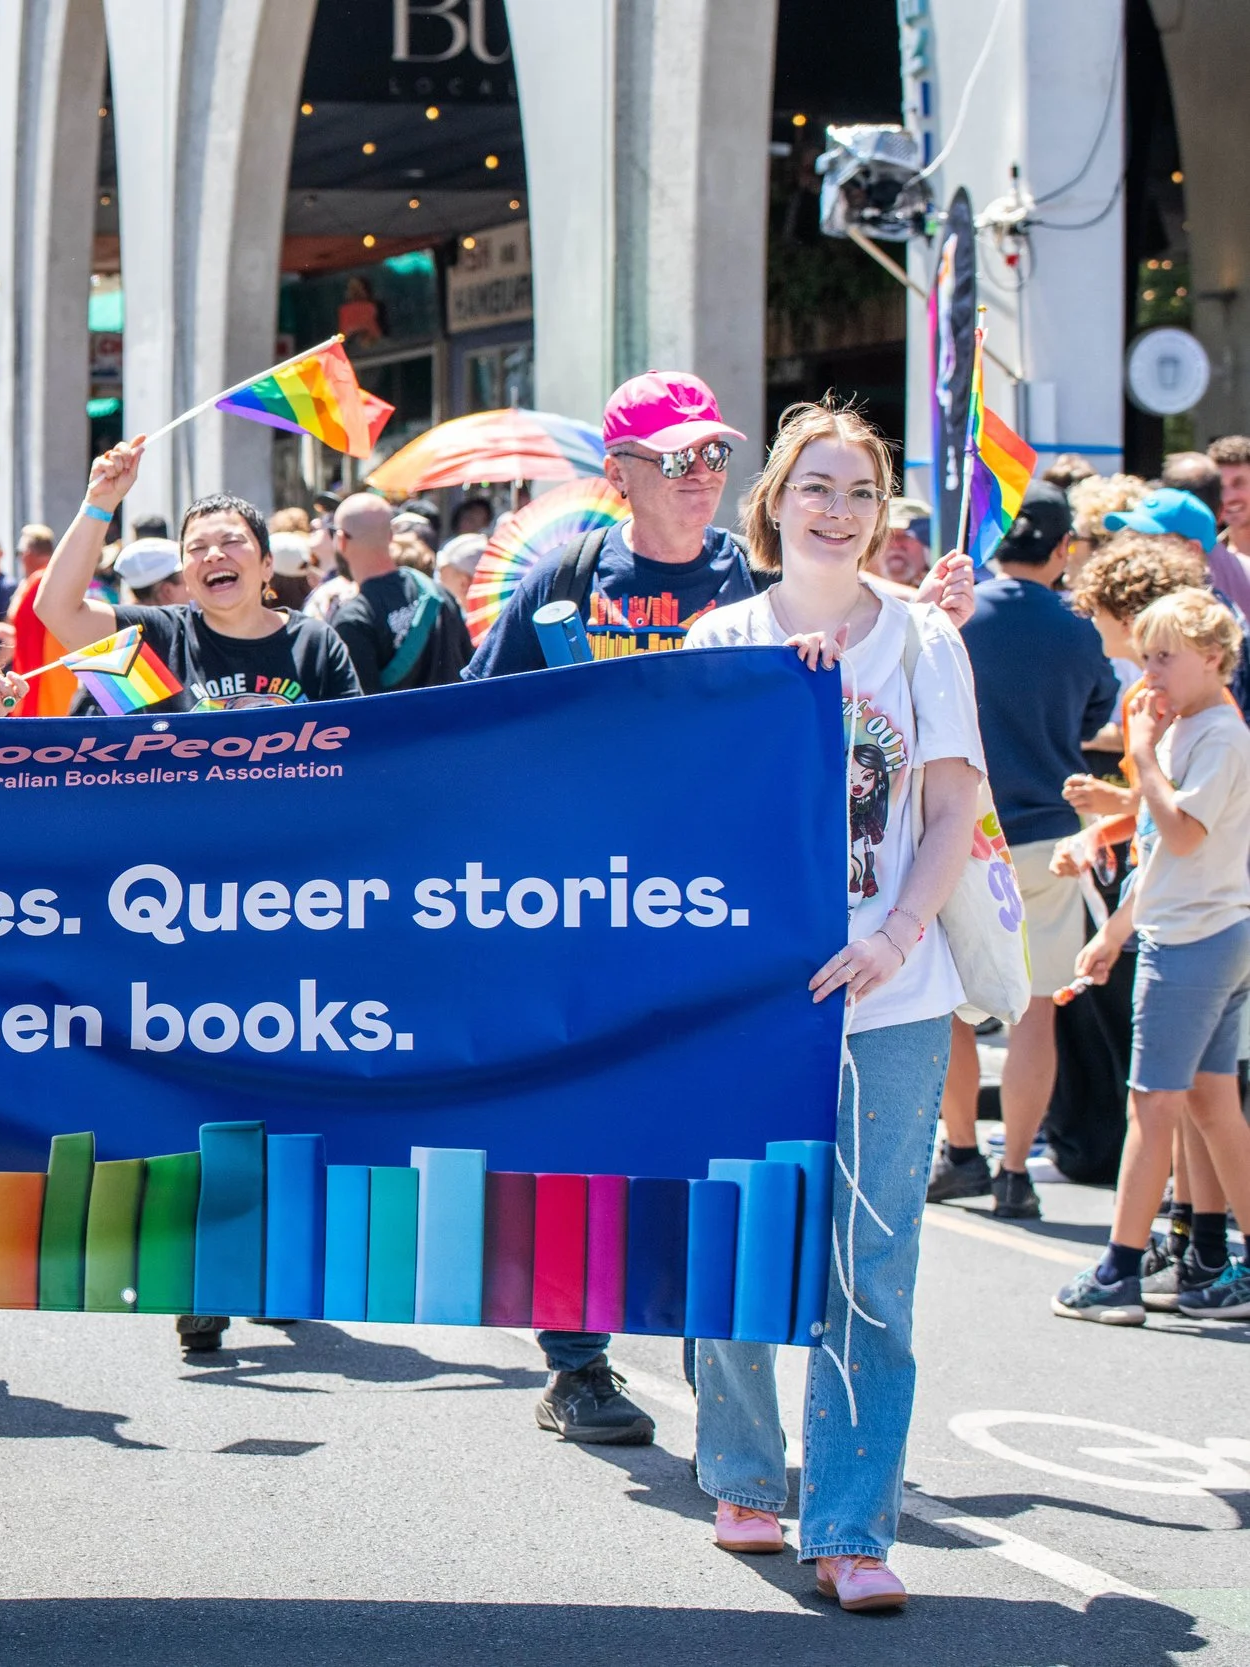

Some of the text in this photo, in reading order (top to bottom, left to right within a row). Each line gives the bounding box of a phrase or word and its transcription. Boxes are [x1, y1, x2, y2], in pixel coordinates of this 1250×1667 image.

[65, 767, 198, 787] Booksellers
[206, 762, 342, 781] Association
[866, 715, 907, 773] OUT!
[108, 864, 389, 944] Queer
[413, 856, 749, 929] stories.
[131, 979, 413, 1052] books.
